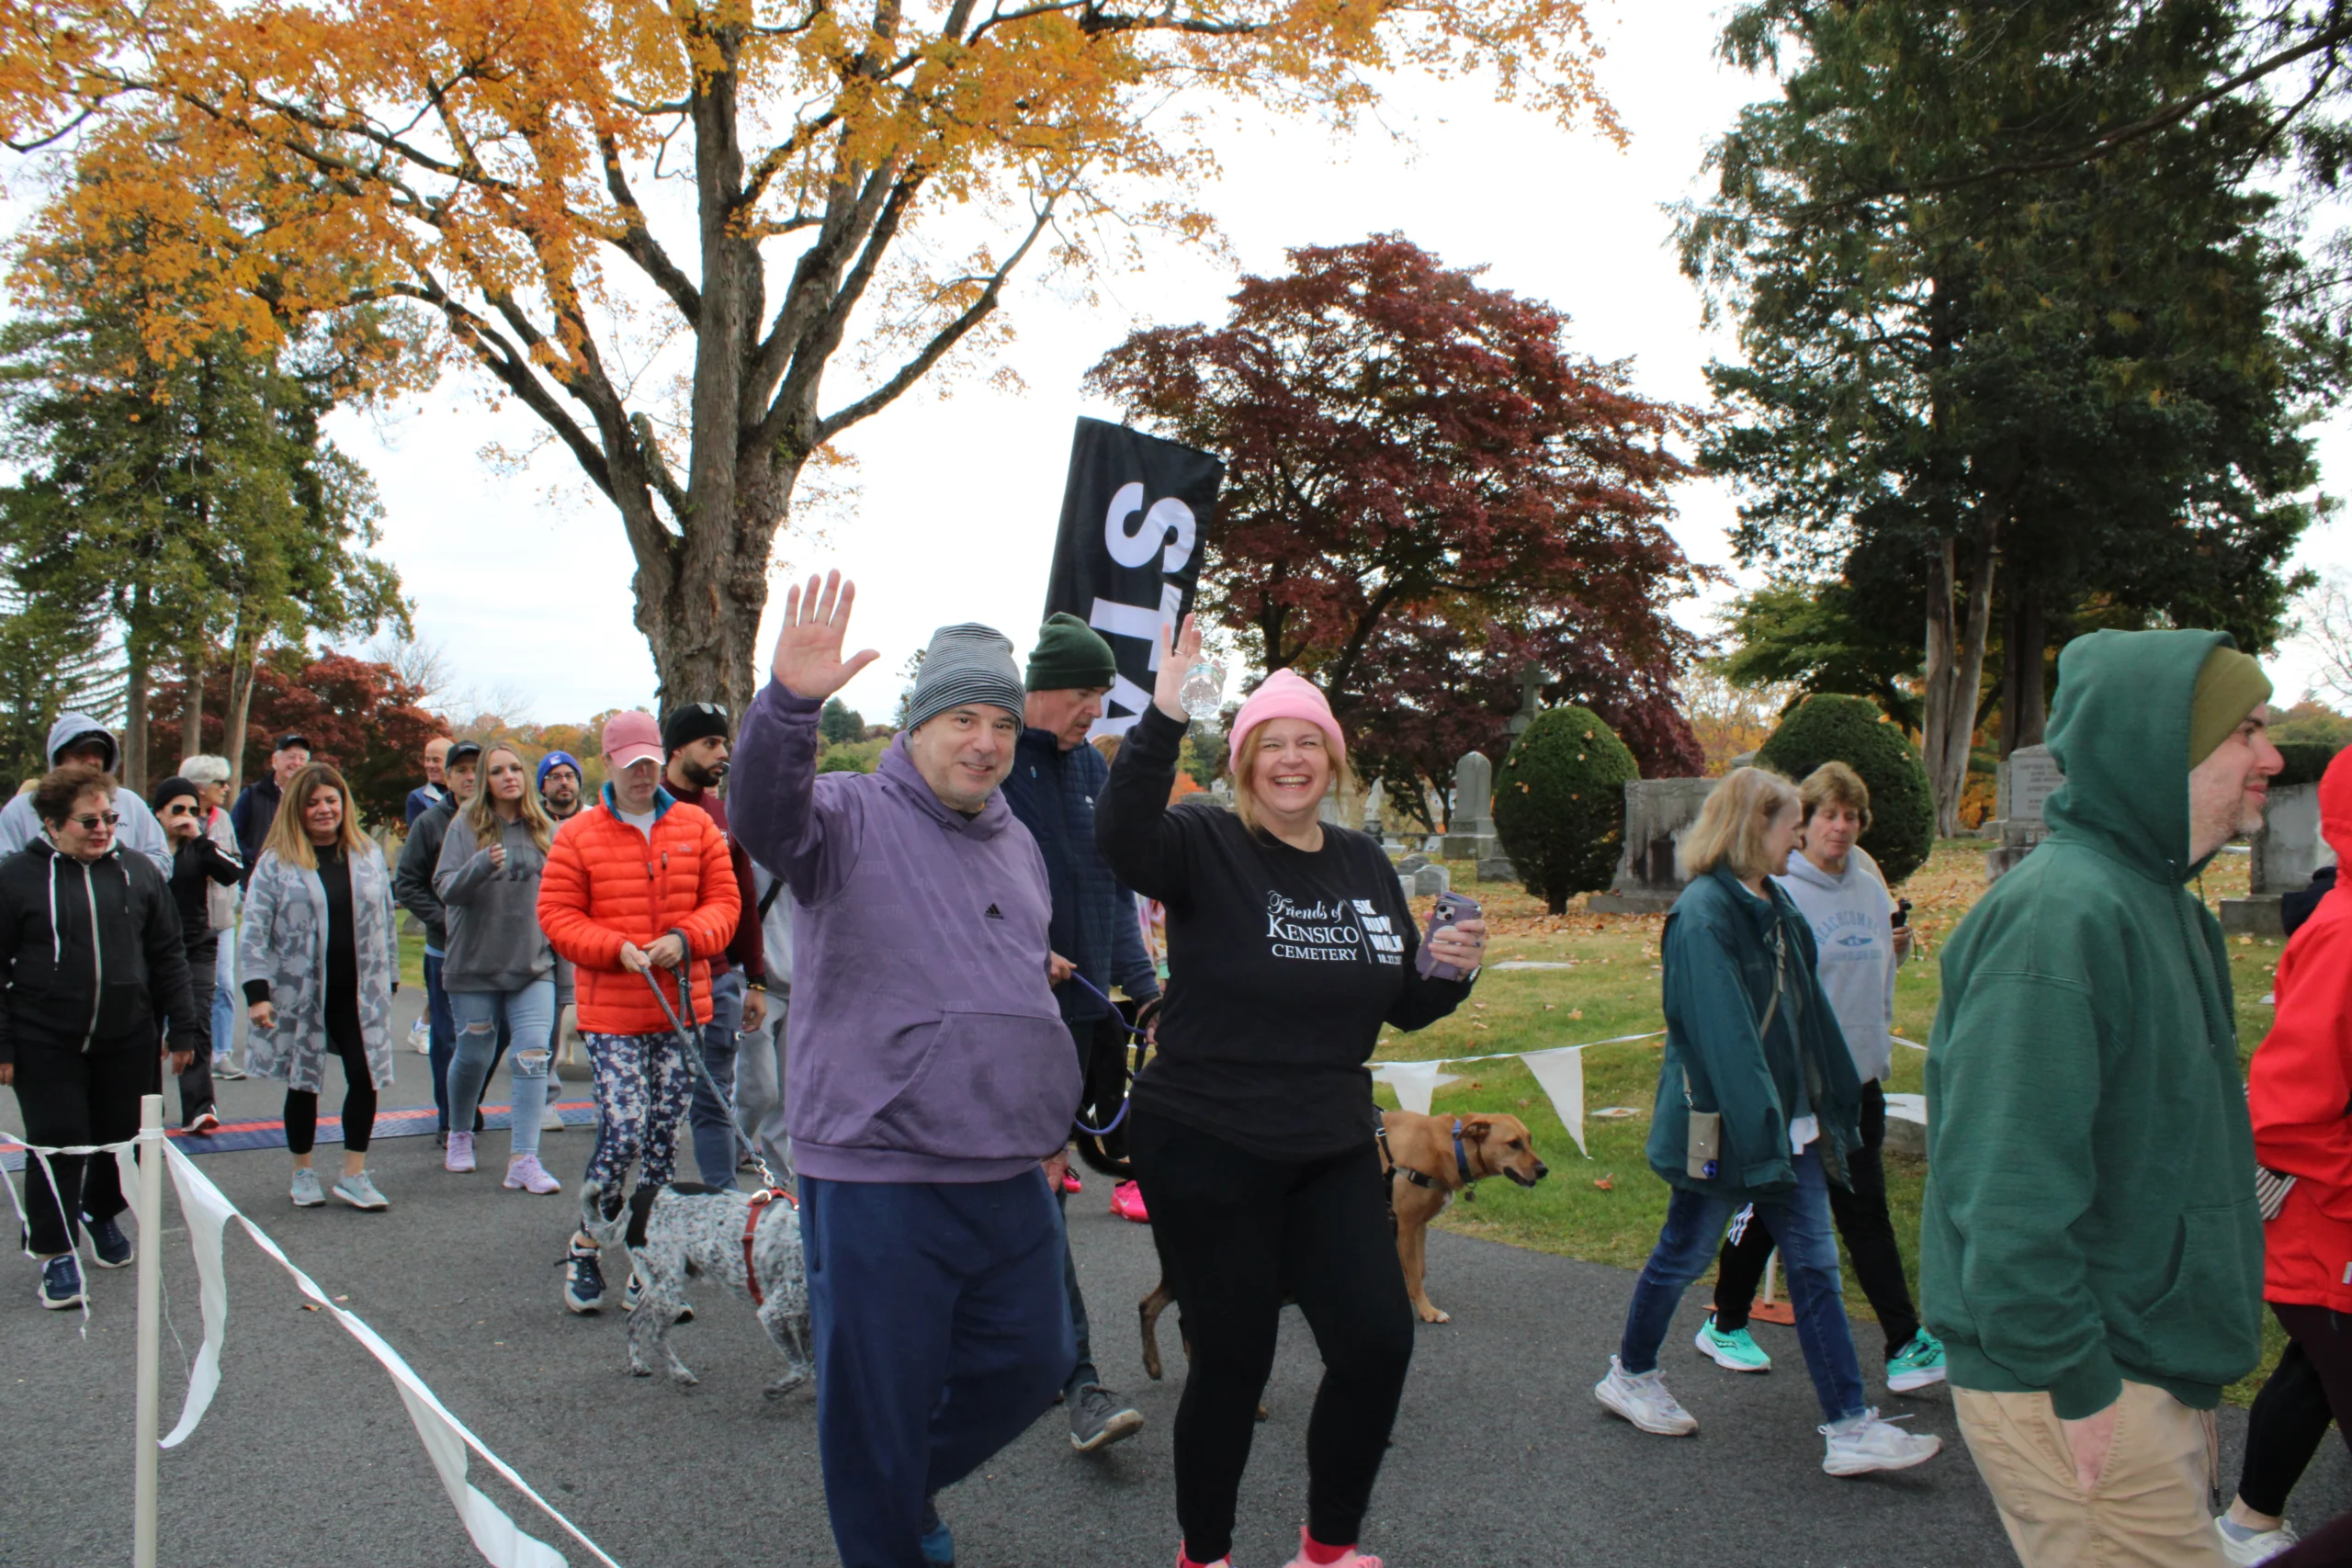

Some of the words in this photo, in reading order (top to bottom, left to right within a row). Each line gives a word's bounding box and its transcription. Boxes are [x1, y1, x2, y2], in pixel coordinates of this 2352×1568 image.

[1267, 889, 1328, 919] Friends
[1330, 900, 1344, 923] of
[1351, 899, 1377, 915] 5K
[1266, 912, 1360, 944] KENSICO
[1272, 943, 1358, 961] CEMETERY
